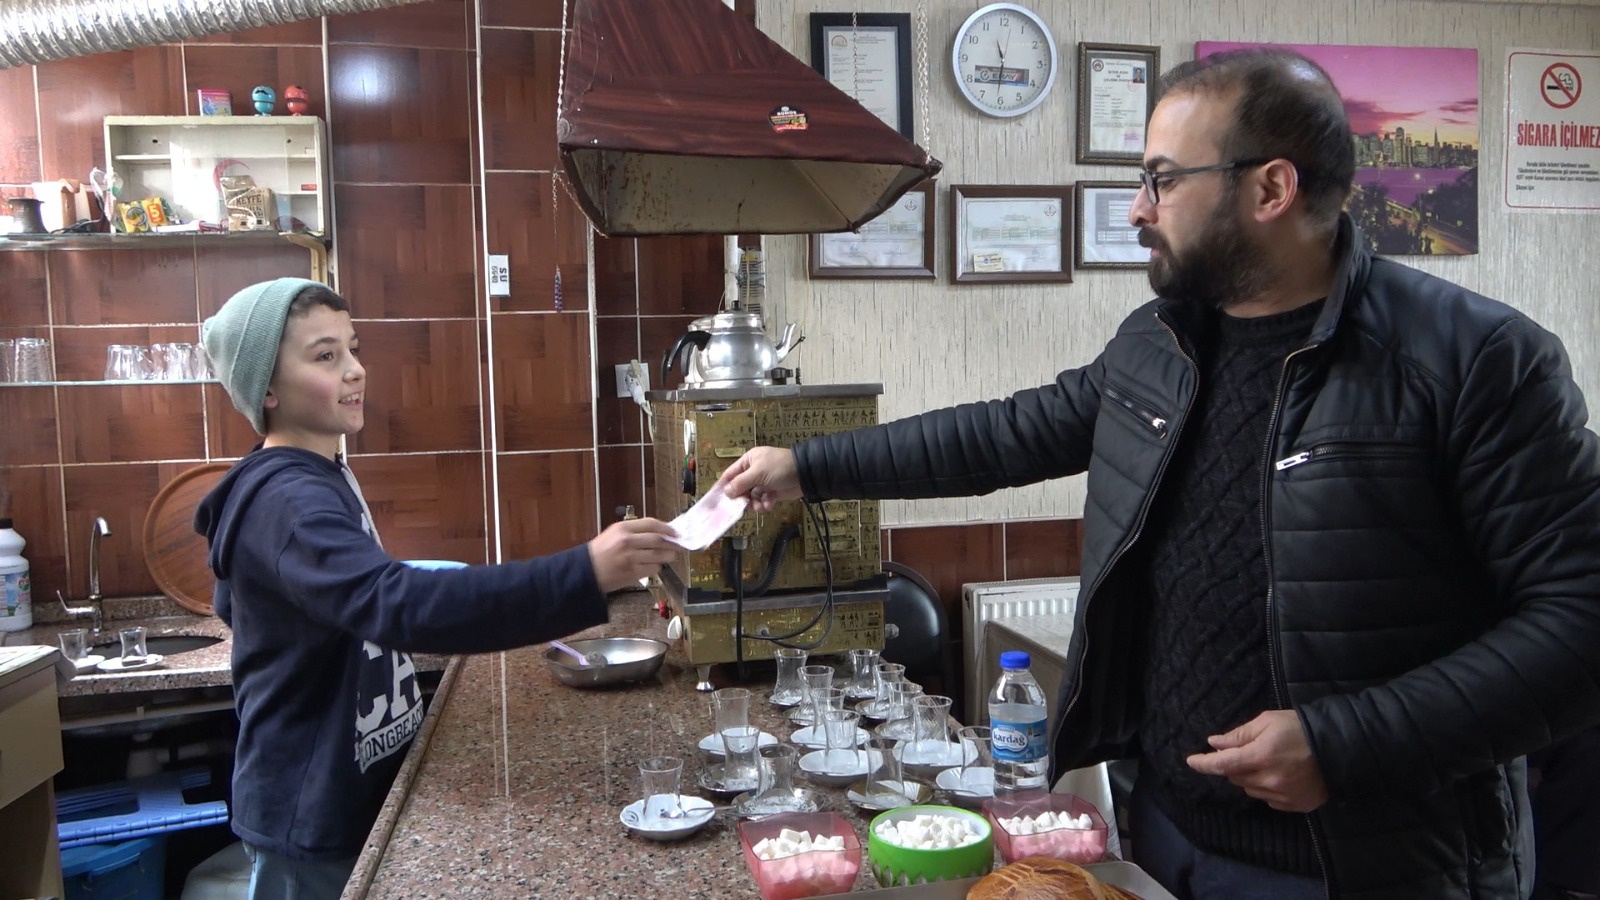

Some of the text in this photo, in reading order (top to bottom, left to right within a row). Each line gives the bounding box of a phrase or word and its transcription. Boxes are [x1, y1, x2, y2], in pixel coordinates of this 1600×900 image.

[982, 22, 990, 31] 11
[1000, 18, 1009, 27] 12
[1020, 26, 1025, 35] 1
[969, 35, 979, 45] 10
[1032, 40, 1039, 50] 2
[961, 54, 968, 63] 9
[1036, 60, 1043, 69] 3
[966, 74, 973, 83] 8
[1029, 80, 1036, 88] 4
[979, 90, 986, 99] 7
[1015, 92, 1022, 101] 5
[997, 96, 1004, 105] 6
[1516, 119, 1600, 151] SİGARA İÇİLMEZ
[236, 194, 262, 206] KEYFE
[149, 205, 160, 218] 5
[499, 267, 508, 282] SU
[360, 702, 424, 767] LONGBEAC
